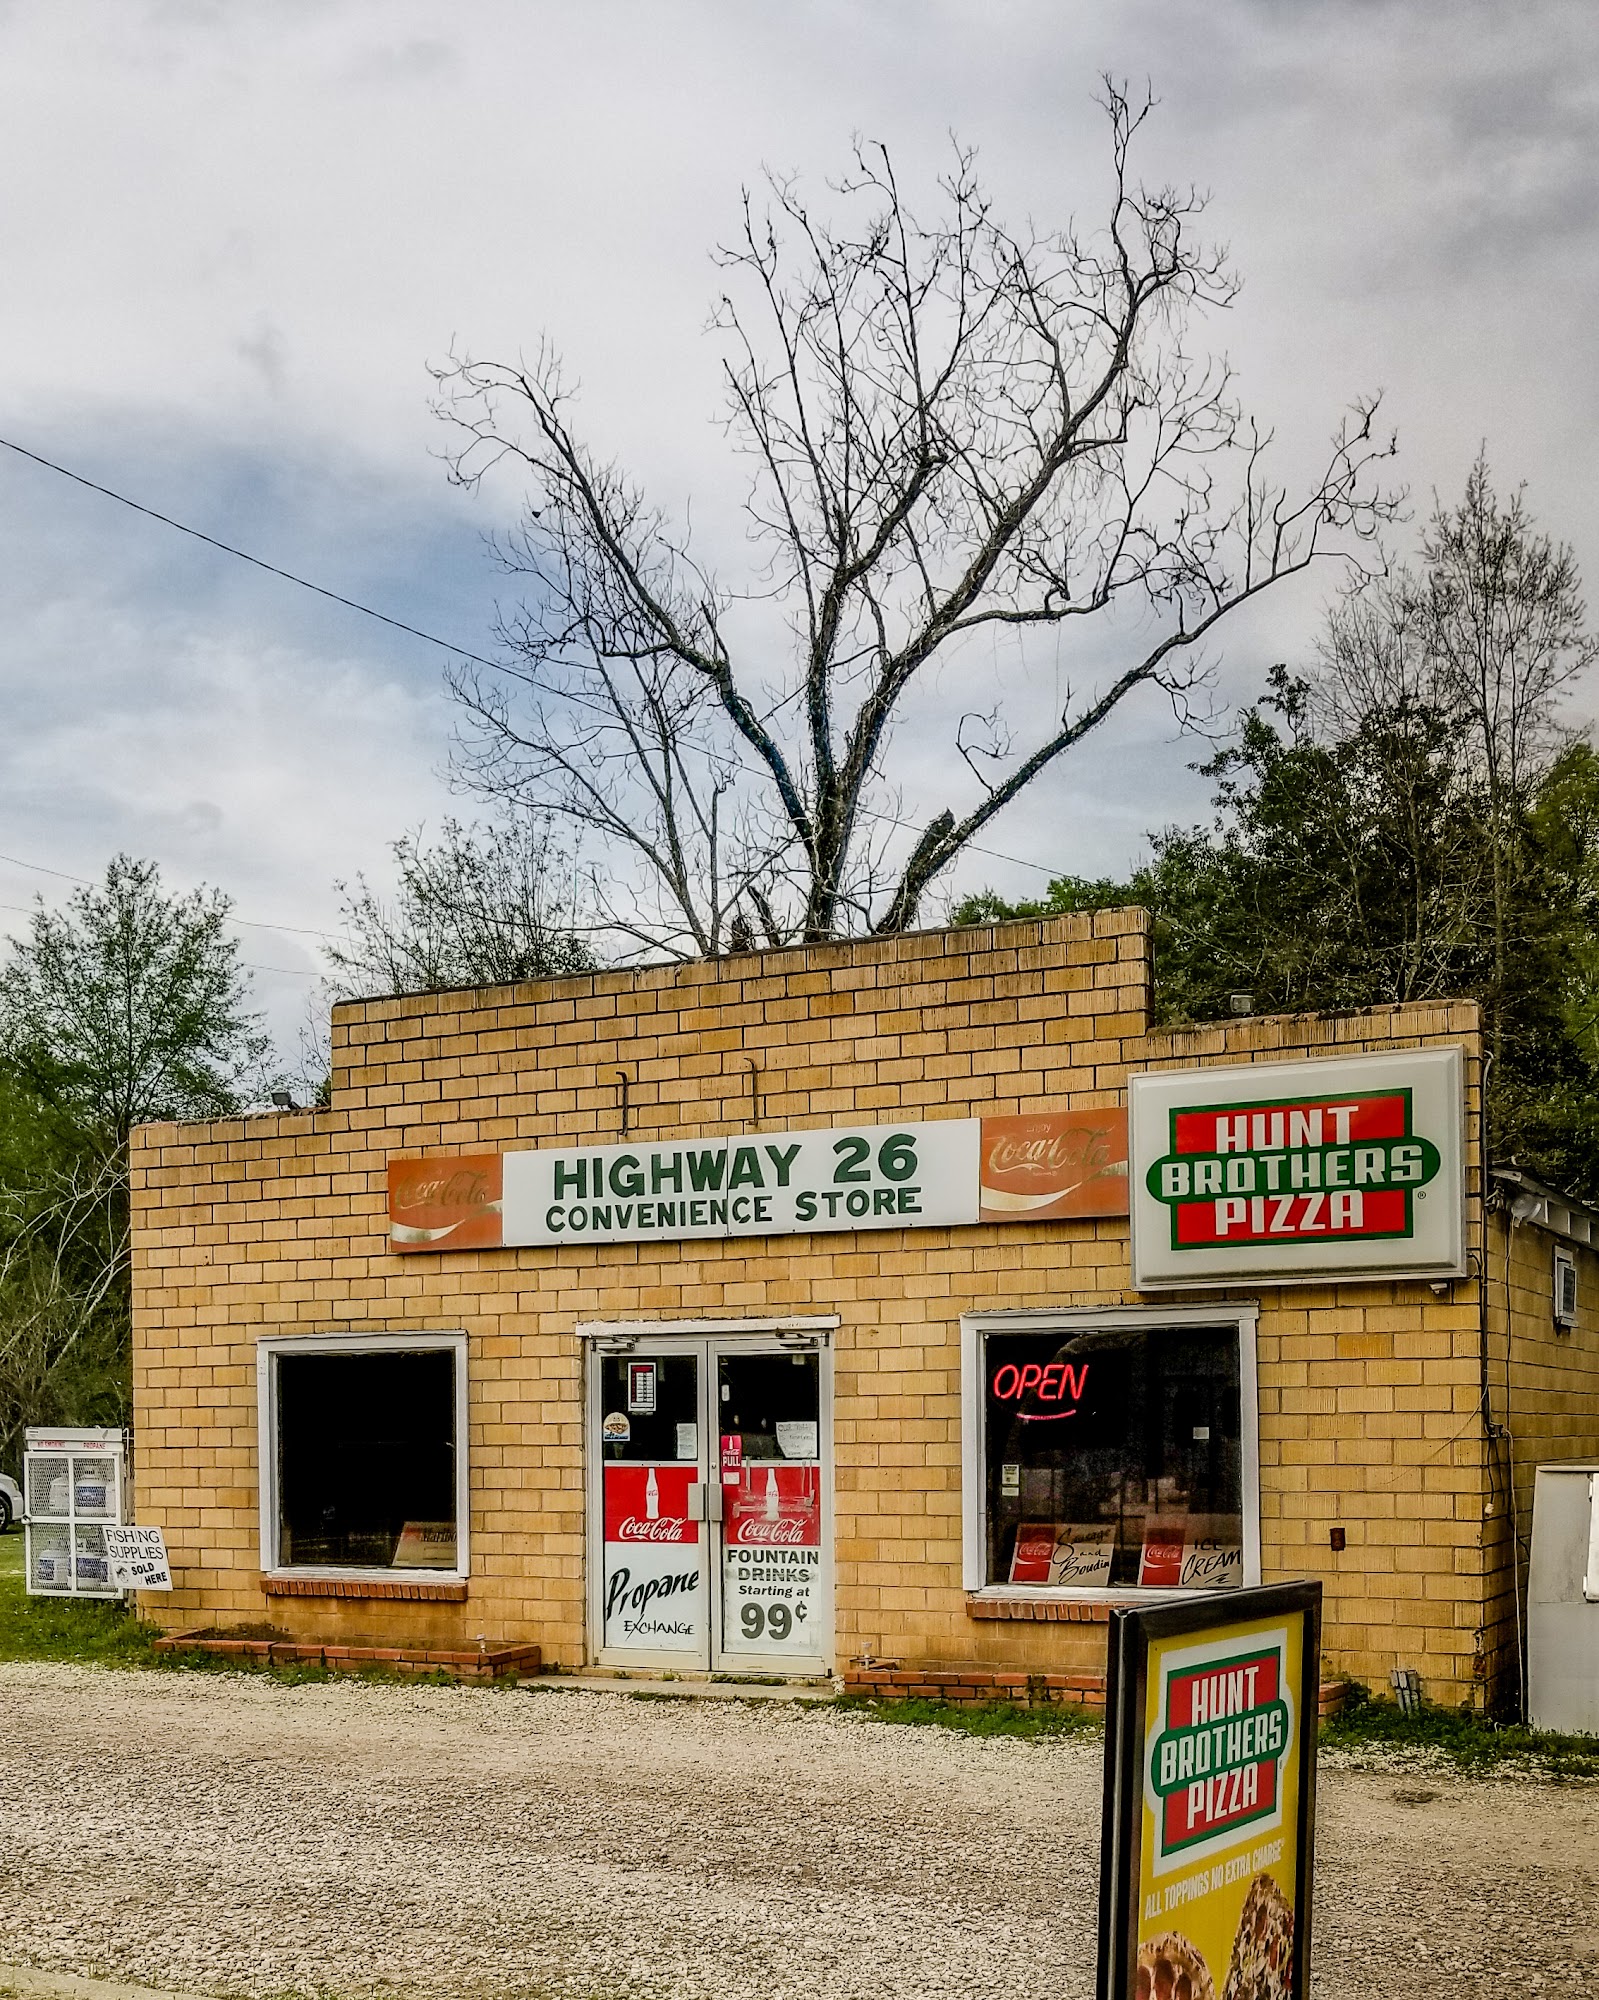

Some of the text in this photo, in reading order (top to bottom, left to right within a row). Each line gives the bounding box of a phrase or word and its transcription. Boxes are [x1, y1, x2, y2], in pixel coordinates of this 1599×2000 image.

[1215, 1106, 1359, 1154] HUNT
[553, 1134, 918, 1200] HIGHWAY 26
[1161, 1145, 1424, 1198] BROTHERS
[544, 1186, 923, 1232] CONVENIENCE STORE
[1215, 1189, 1364, 1236] PIZZA
[993, 1364, 1089, 1400] OPEN
[722, 1456, 741, 1467] PULL
[105, 1529, 160, 1543] FISHING
[619, 1517, 687, 1541] Coca-Cola
[737, 1518, 807, 1543] Coca-Cola
[109, 1545, 163, 1559] SUPPLIES
[728, 1549, 819, 1565] FOUNTAIN
[1079, 1549, 1110, 1557] and
[1194, 1538, 1224, 1550] ICE
[131, 1562, 155, 1576] SOLD
[144, 1572, 168, 1586] HERE
[738, 1568, 810, 1583] DRINKS
[1058, 1557, 1110, 1585] Boudin
[1182, 1549, 1241, 1586] CREAM
[606, 1567, 699, 1620] Propane
[738, 1585, 810, 1599] Starting at
[623, 1614, 695, 1641] EXCHANGE
[740, 1601, 808, 1640] 99¢
[1191, 1666, 1260, 1727] HUNT
[1160, 1709, 1282, 1786] BROTHERS
[1186, 1762, 1258, 1830] PIZZA
[1144, 1889, 1162, 1920] ALL
[1165, 1870, 1210, 1911] TOPPINGS
[1211, 1864, 1224, 1890] NO
[1225, 1852, 1250, 1884] EXTRA
